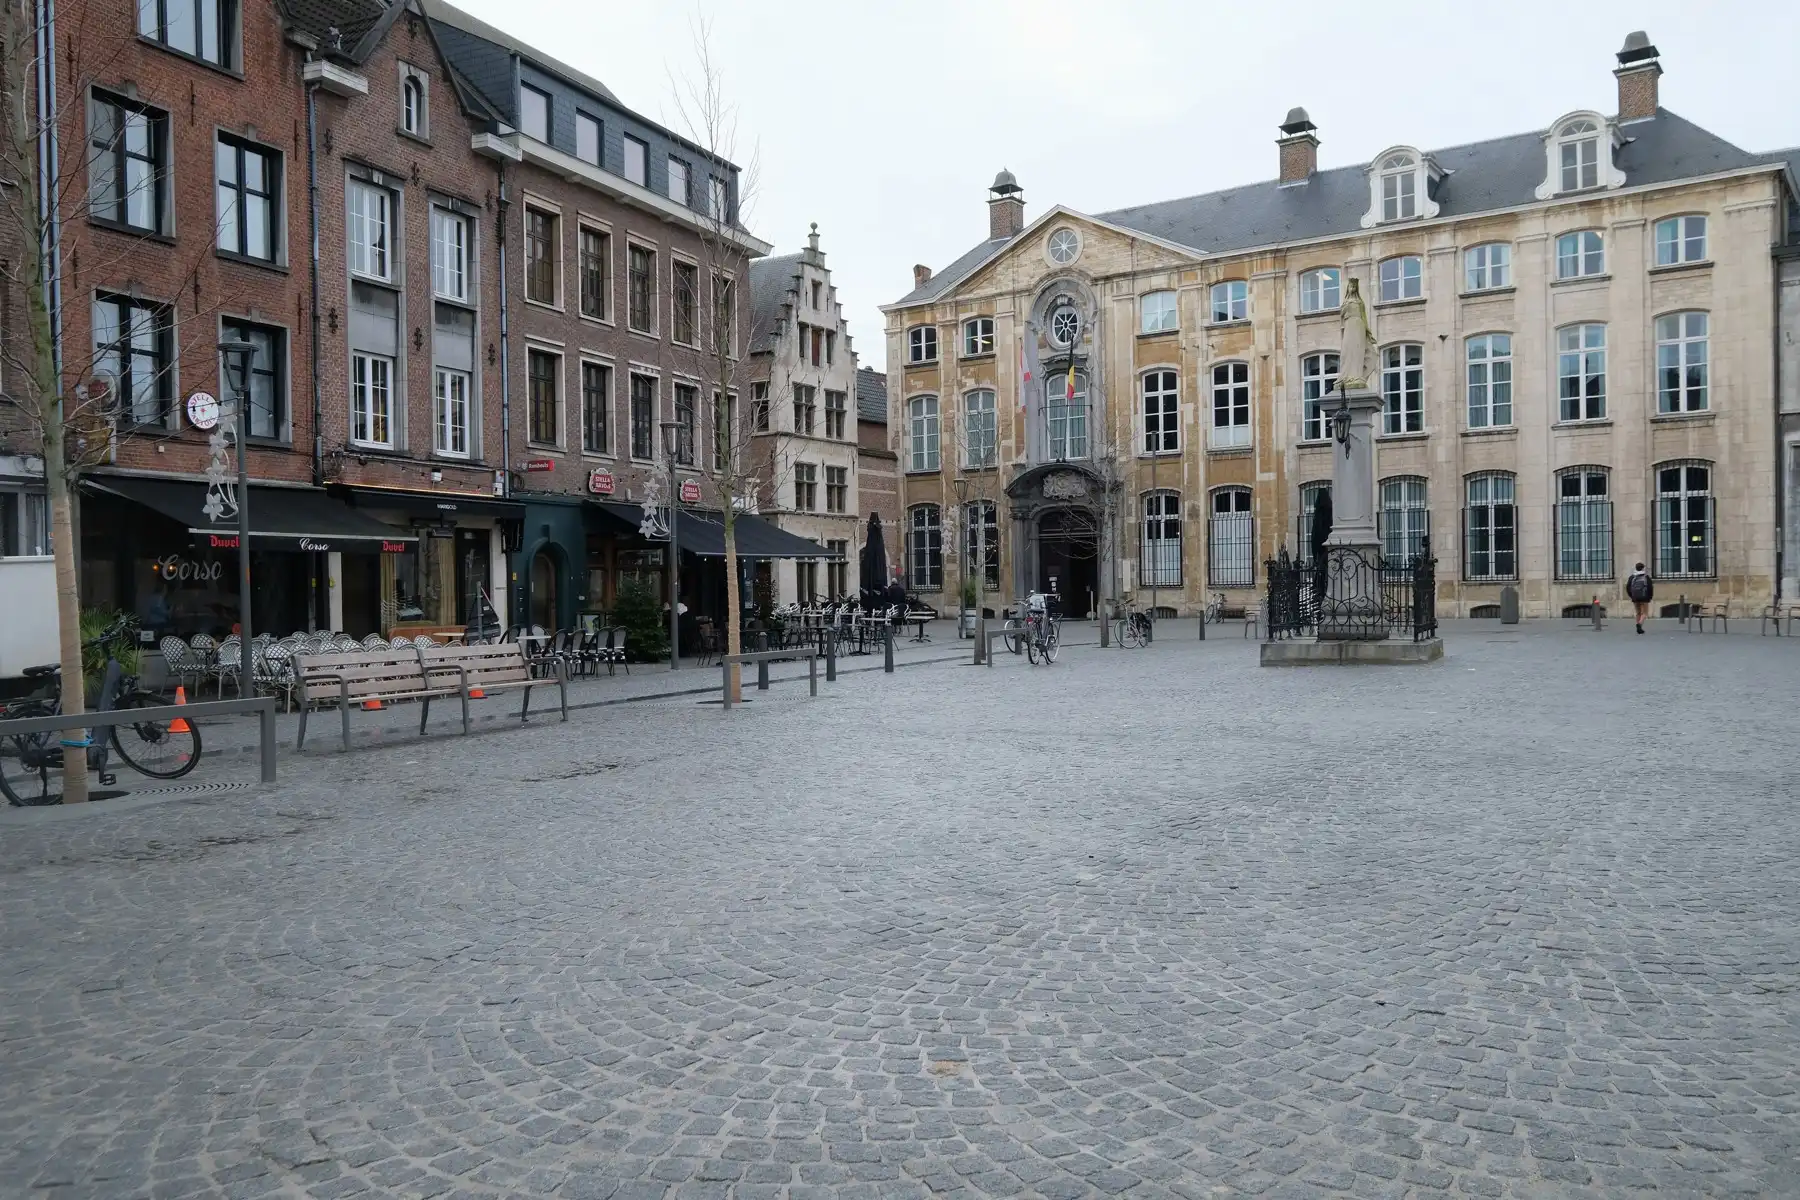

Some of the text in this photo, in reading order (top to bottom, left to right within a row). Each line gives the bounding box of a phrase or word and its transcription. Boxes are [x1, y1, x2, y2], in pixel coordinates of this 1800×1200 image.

[210, 535, 240, 548] Duvel
[299, 538, 330, 551] Corso
[383, 541, 405, 552] Duvel
[158, 554, 223, 581] Corso
